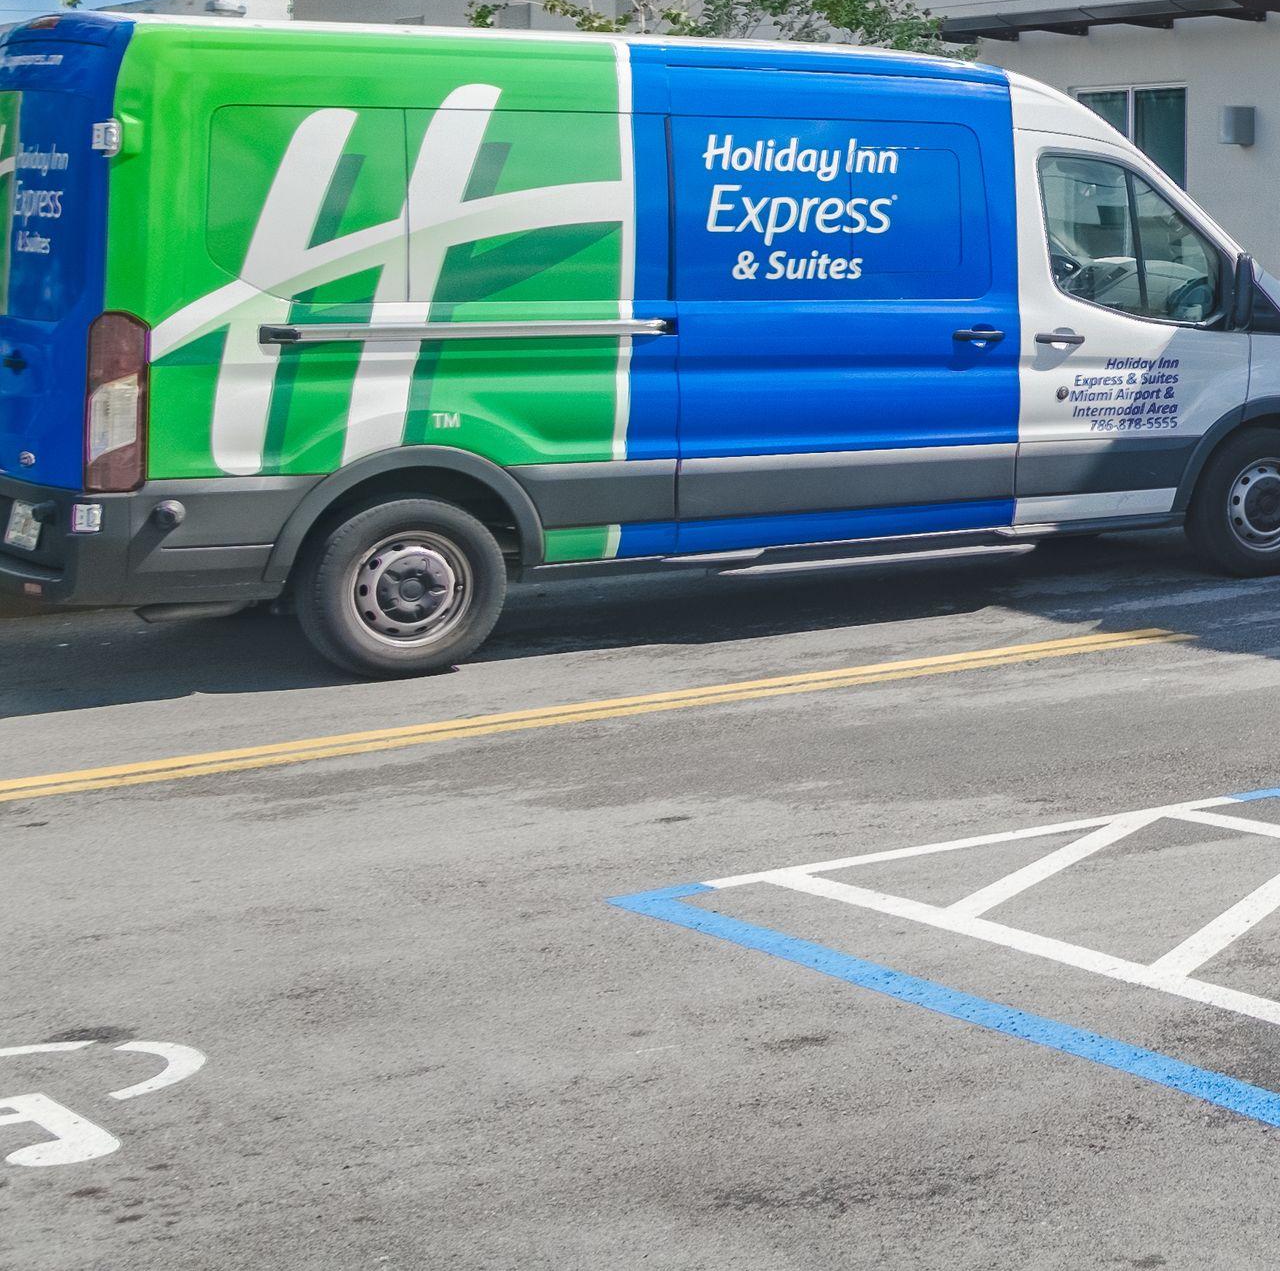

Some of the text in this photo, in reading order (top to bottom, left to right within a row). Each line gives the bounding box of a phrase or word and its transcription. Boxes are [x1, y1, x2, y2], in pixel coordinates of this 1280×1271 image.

[702, 134, 899, 181] Holiday Inn
[14, 180, 63, 226] Express
[706, 184, 892, 246] Express
[732, 250, 864, 280] & Suites
[1105, 356, 1179, 372] Holiday Inn
[1074, 372, 1179, 389] Express & Suites
[1069, 386, 1175, 402] Miami Airport &
[1073, 402, 1178, 417] Intermodal Area
[432, 412, 461, 428] TM
[1090, 416, 1178, 431] 786-878-5555
